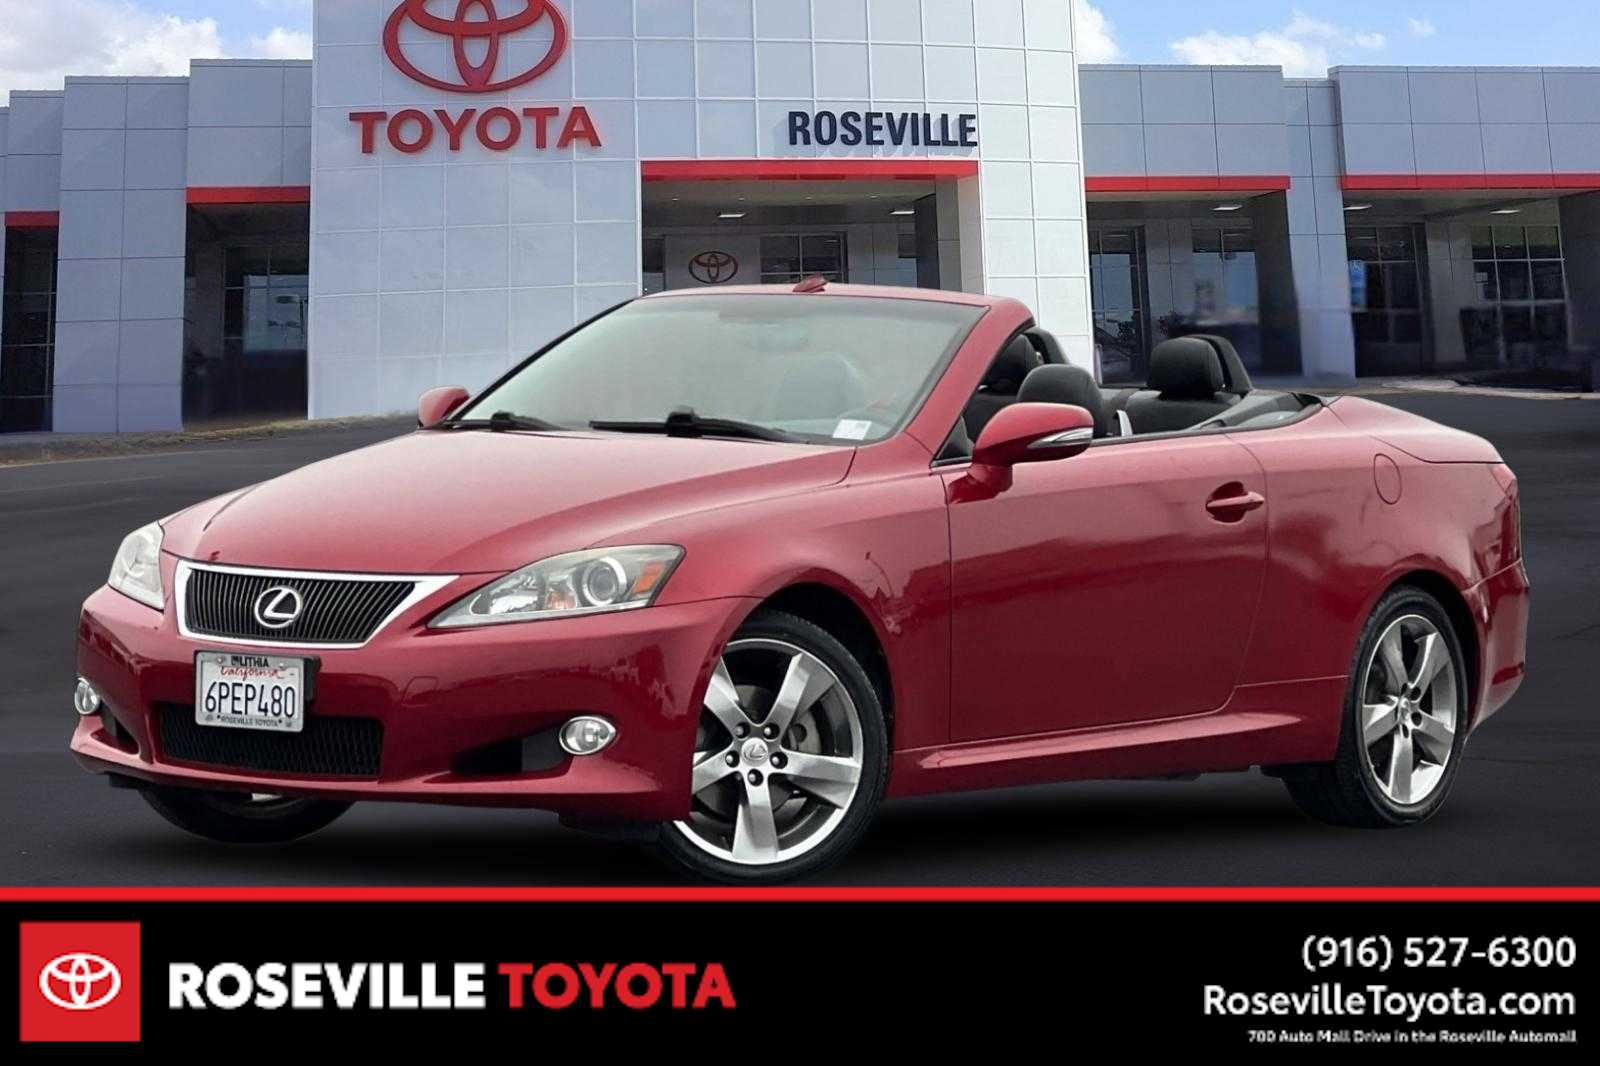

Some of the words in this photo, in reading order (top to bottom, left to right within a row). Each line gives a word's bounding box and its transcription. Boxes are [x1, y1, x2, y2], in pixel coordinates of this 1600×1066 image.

[349, 106, 602, 154] TOYOTA
[788, 111, 979, 148] ROSEVILLE
[205, 681, 296, 718] 6PEP480
